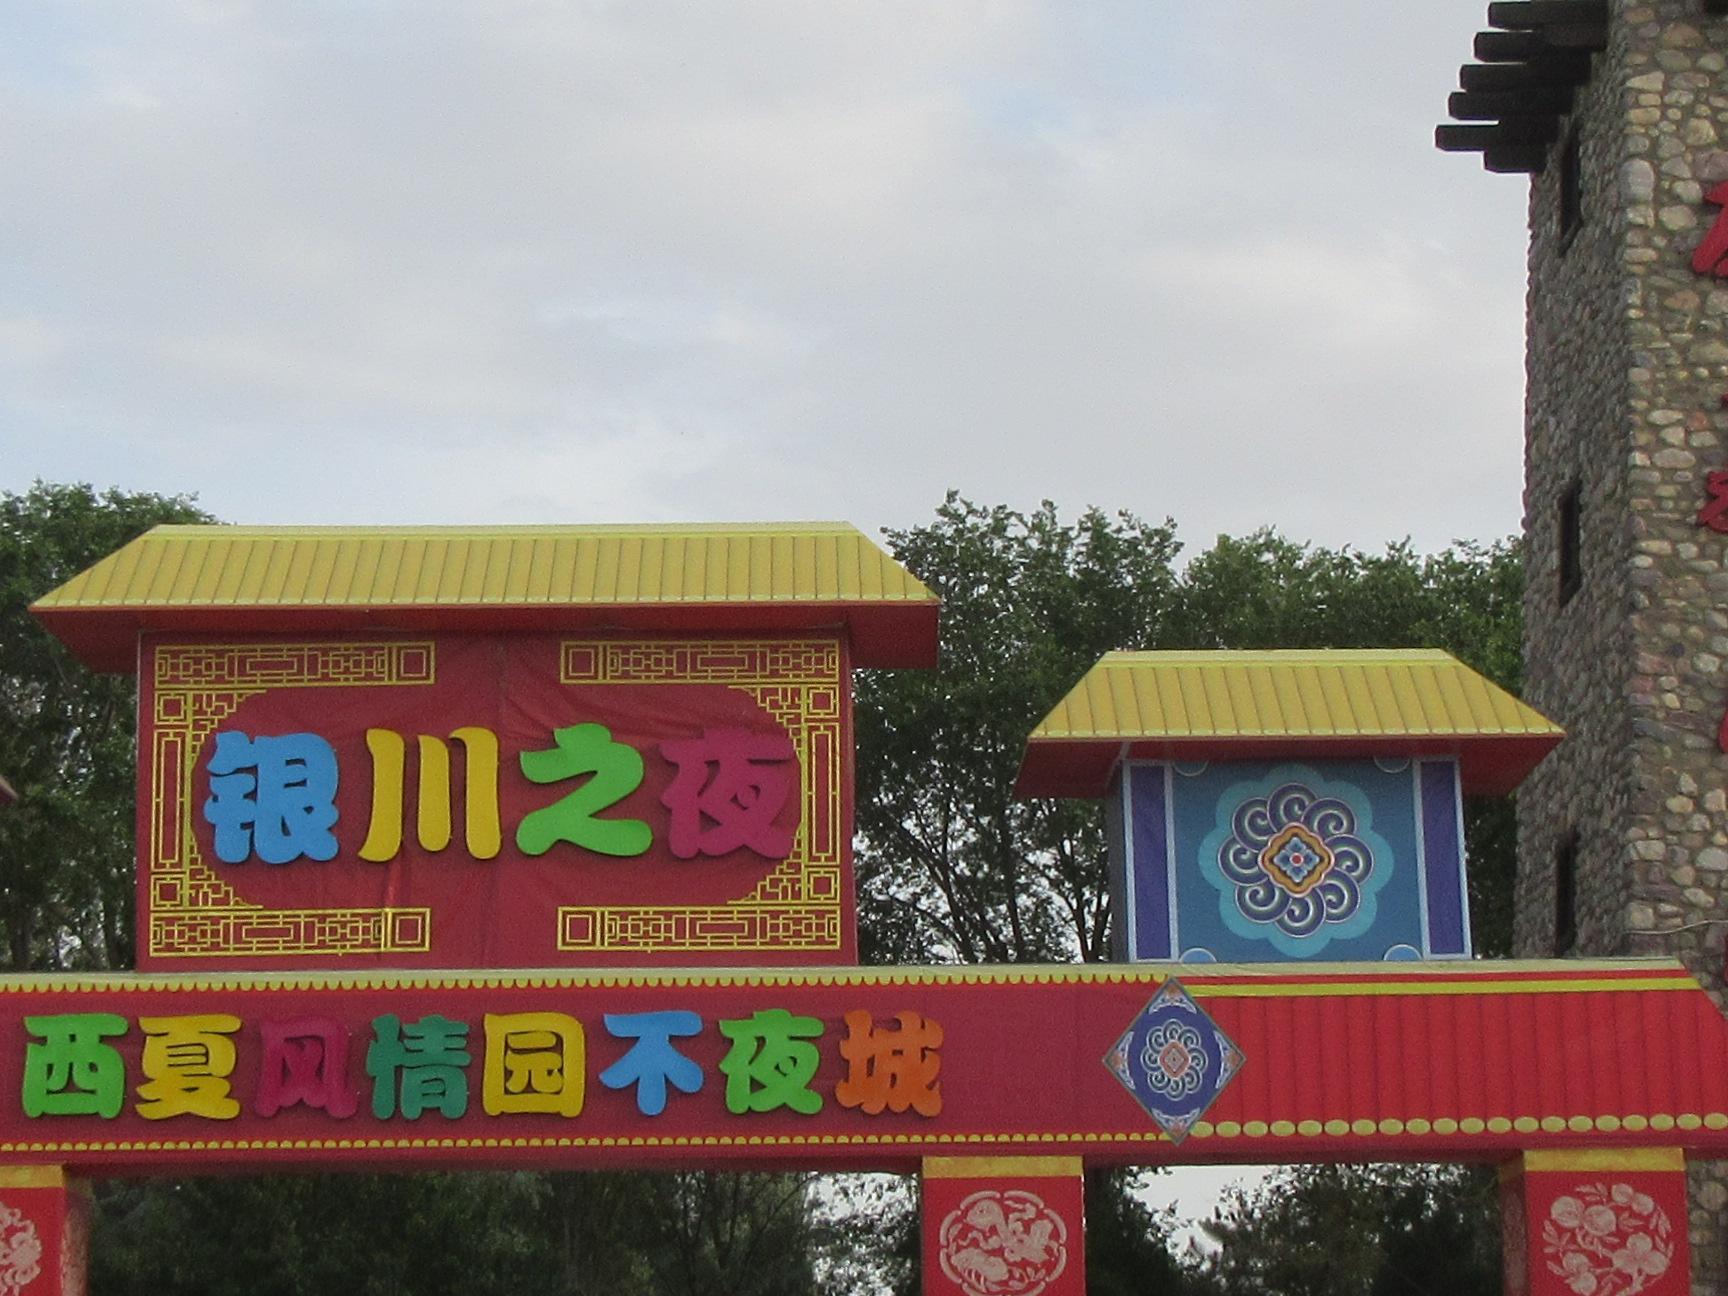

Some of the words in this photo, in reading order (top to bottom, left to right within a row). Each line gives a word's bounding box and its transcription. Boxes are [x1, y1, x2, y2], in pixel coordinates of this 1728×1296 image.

[203, 722, 799, 865] 银川之夜
[21, 1007, 945, 1121] 西夏风情园不夜城
